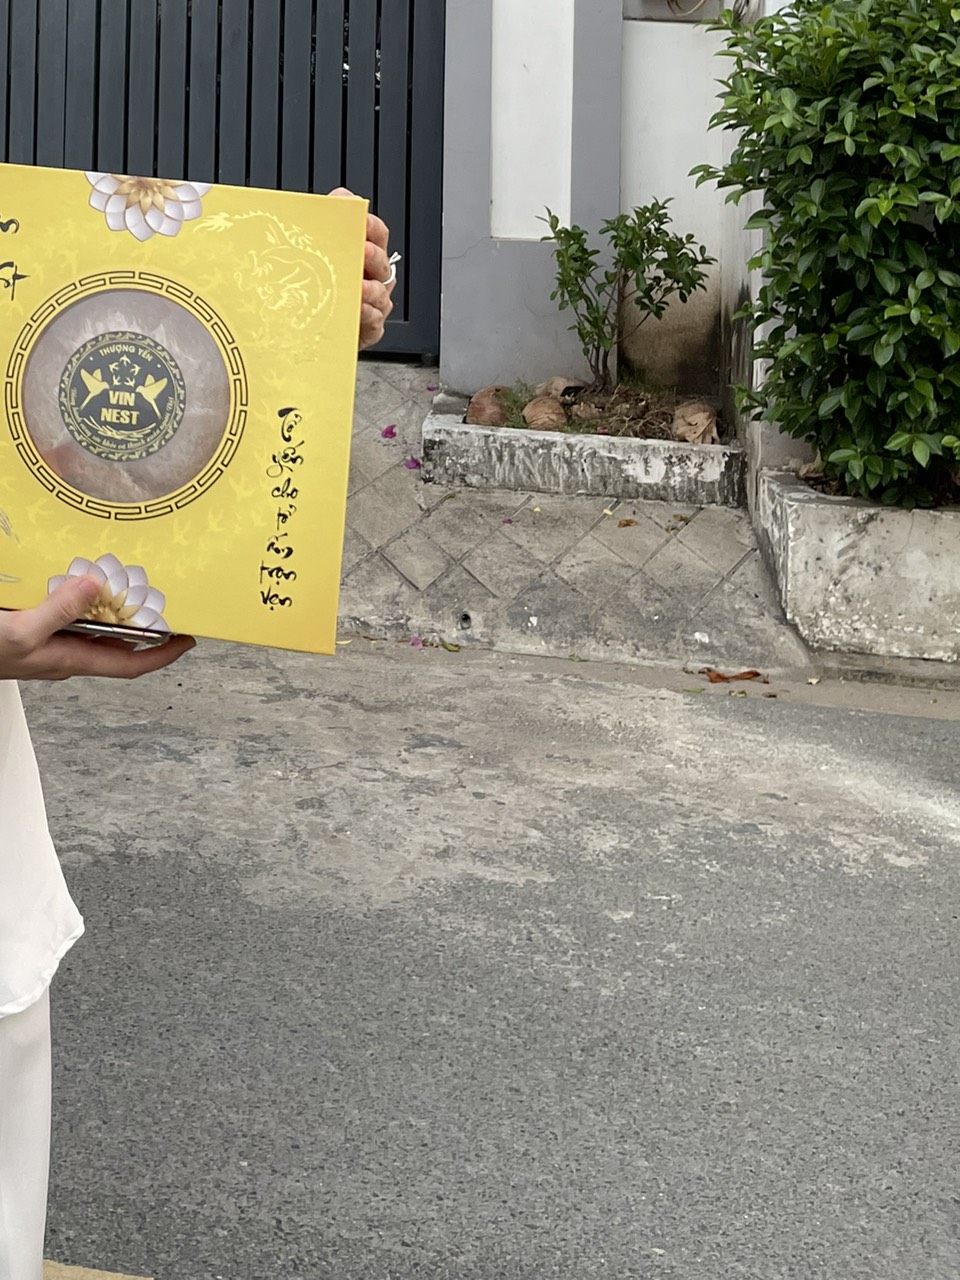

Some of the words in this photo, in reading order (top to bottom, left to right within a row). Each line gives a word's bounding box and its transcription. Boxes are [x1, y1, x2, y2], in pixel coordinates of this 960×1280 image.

[99, 344, 136, 357] THƯỢNG
[108, 390, 136, 407] VIN
[100, 408, 140, 425] NEST
[271, 477, 299, 499] cho
